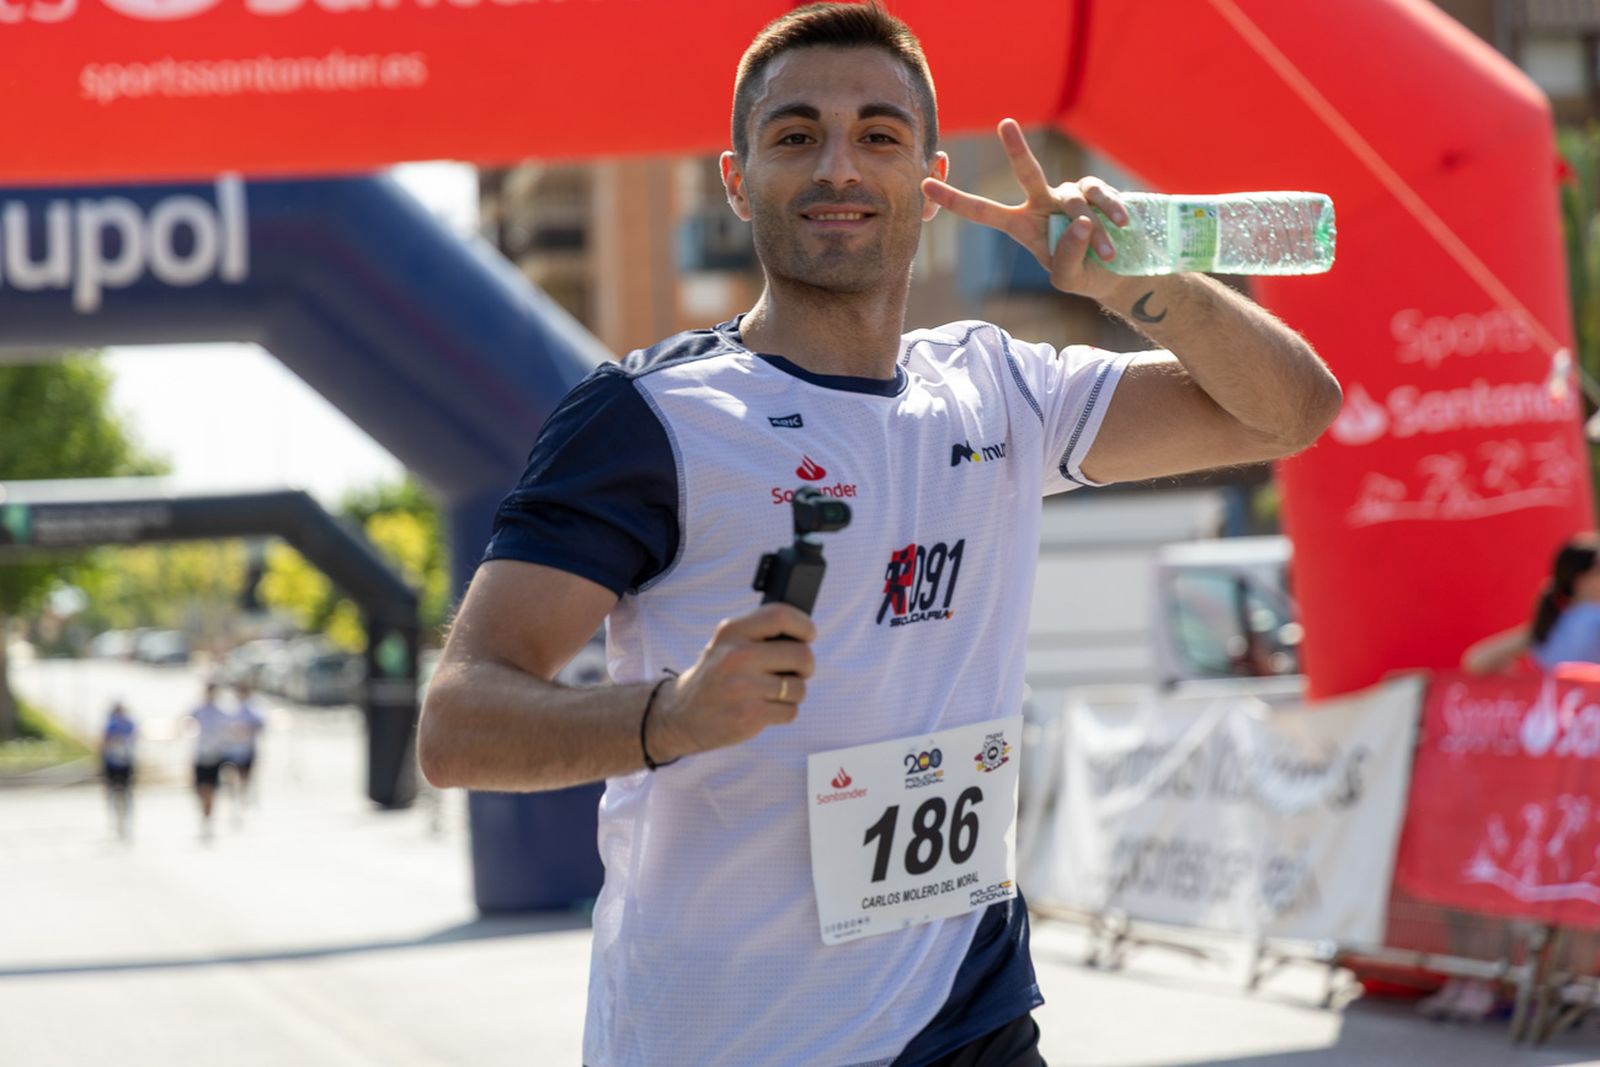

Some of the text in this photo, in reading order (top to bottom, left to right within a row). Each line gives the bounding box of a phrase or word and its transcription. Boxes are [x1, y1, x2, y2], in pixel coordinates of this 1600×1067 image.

[0, 173, 249, 312] upol
[816, 787, 868, 805] Santander
[863, 786, 984, 883] 186
[861, 871, 980, 910] CARLOS MOLERO DEL MORAL
